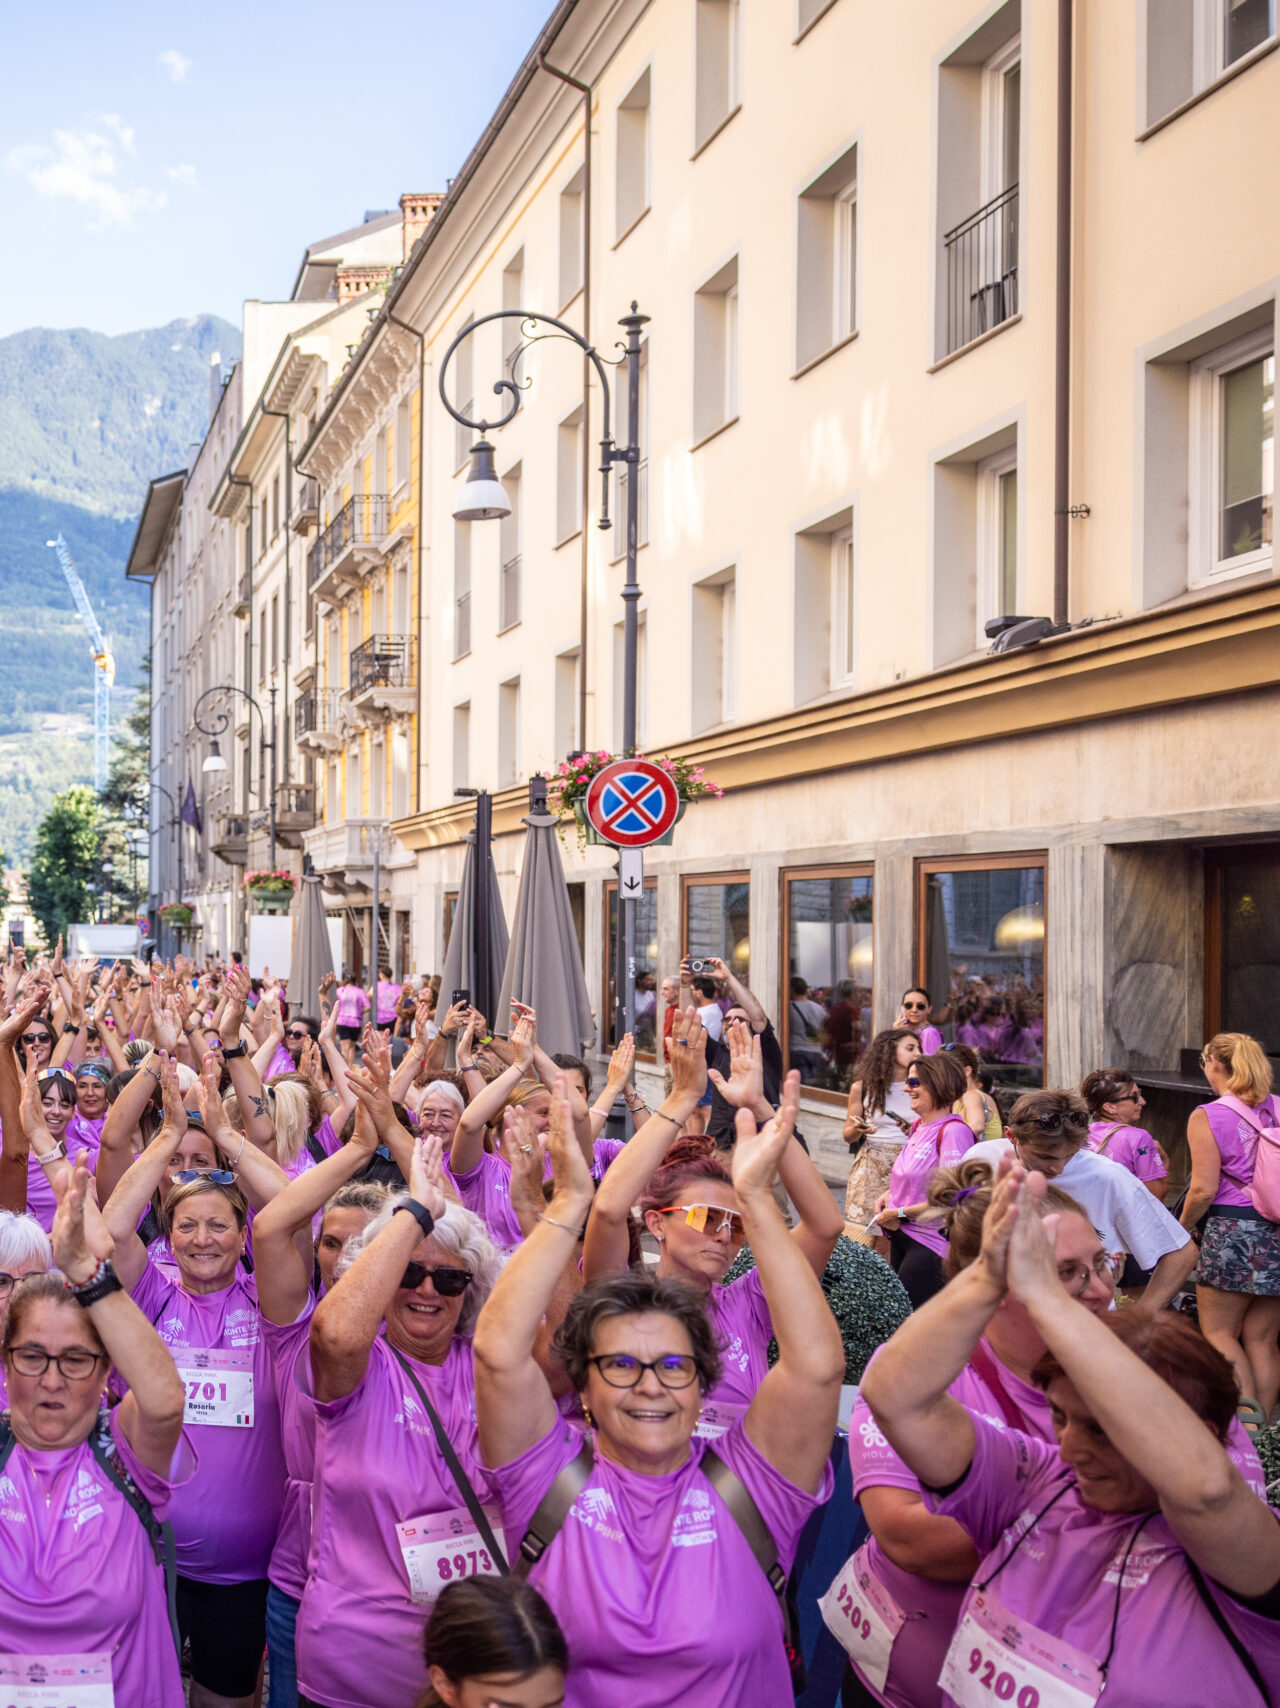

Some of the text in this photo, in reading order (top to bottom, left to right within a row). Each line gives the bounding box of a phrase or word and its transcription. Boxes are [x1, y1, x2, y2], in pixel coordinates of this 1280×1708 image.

[183, 1381, 227, 1402] 701
[188, 1402, 216, 1411] Rosaria
[862, 1451, 894, 1460] VIOLA
[594, 1521, 624, 1544] PINK
[437, 1548, 493, 1581] 8973
[837, 1583, 872, 1640] 9209
[968, 1647, 1040, 1708] 9200
